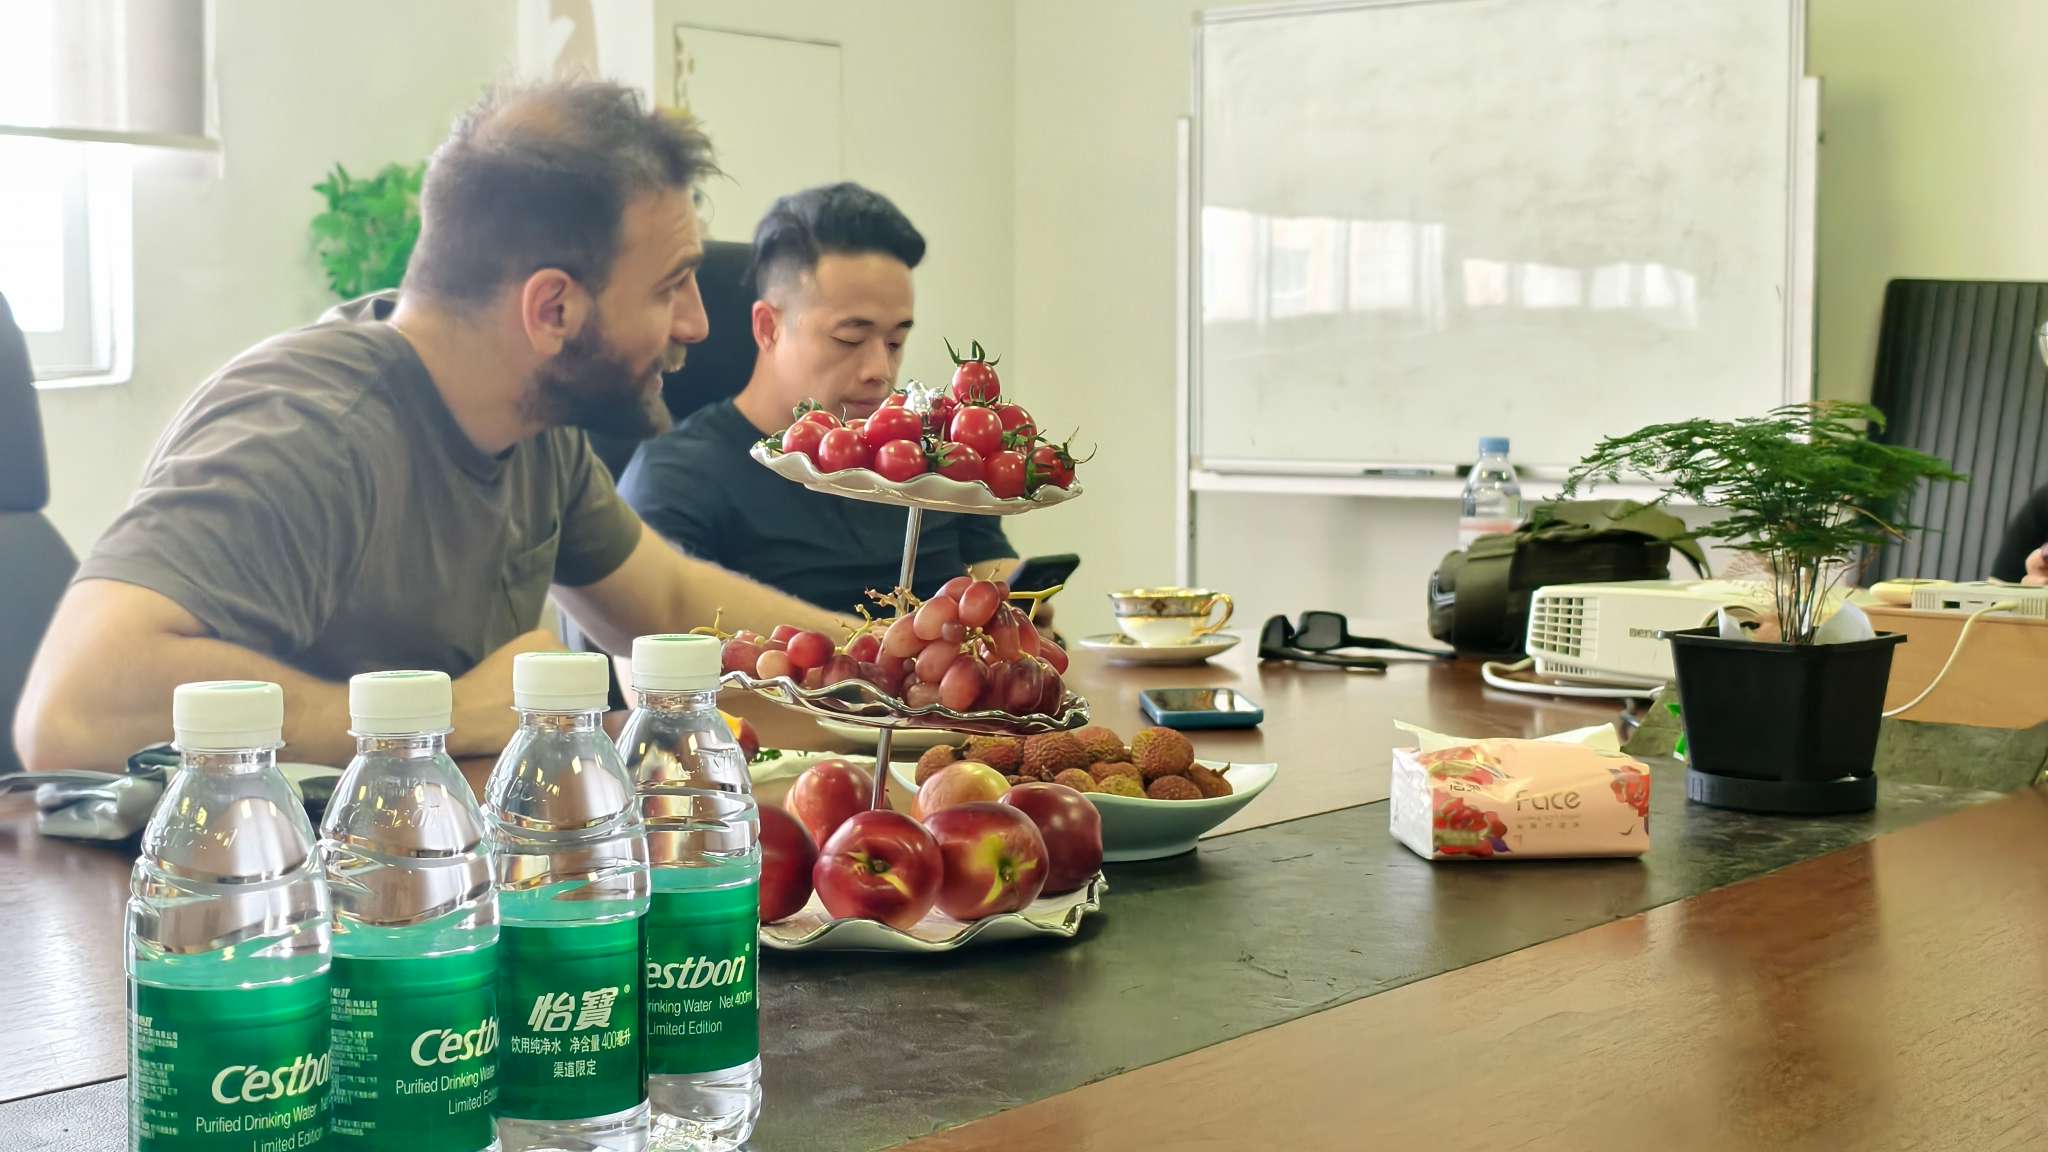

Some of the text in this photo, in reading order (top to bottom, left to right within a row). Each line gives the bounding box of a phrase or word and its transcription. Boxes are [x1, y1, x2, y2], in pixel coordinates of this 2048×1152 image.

[1629, 627, 1658, 639] Ben
[528, 986, 619, 1032] 怡寶
[648, 999, 681, 1017] rinking
[683, 999, 713, 1013] Water
[720, 995, 734, 1009] Net
[688, 1020, 723, 1035] Edition
[511, 1036, 562, 1055] 饮用纯净水
[553, 1059, 597, 1078] 渠道限定
[396, 1077, 438, 1095] Purified
[441, 1072, 479, 1091] Drinking
[448, 1091, 482, 1115] Limited
[195, 1116, 241, 1134] Purified
[244, 1111, 291, 1131] Drinking
[292, 1103, 318, 1122] Water
[253, 1132, 295, 1152] Limited
